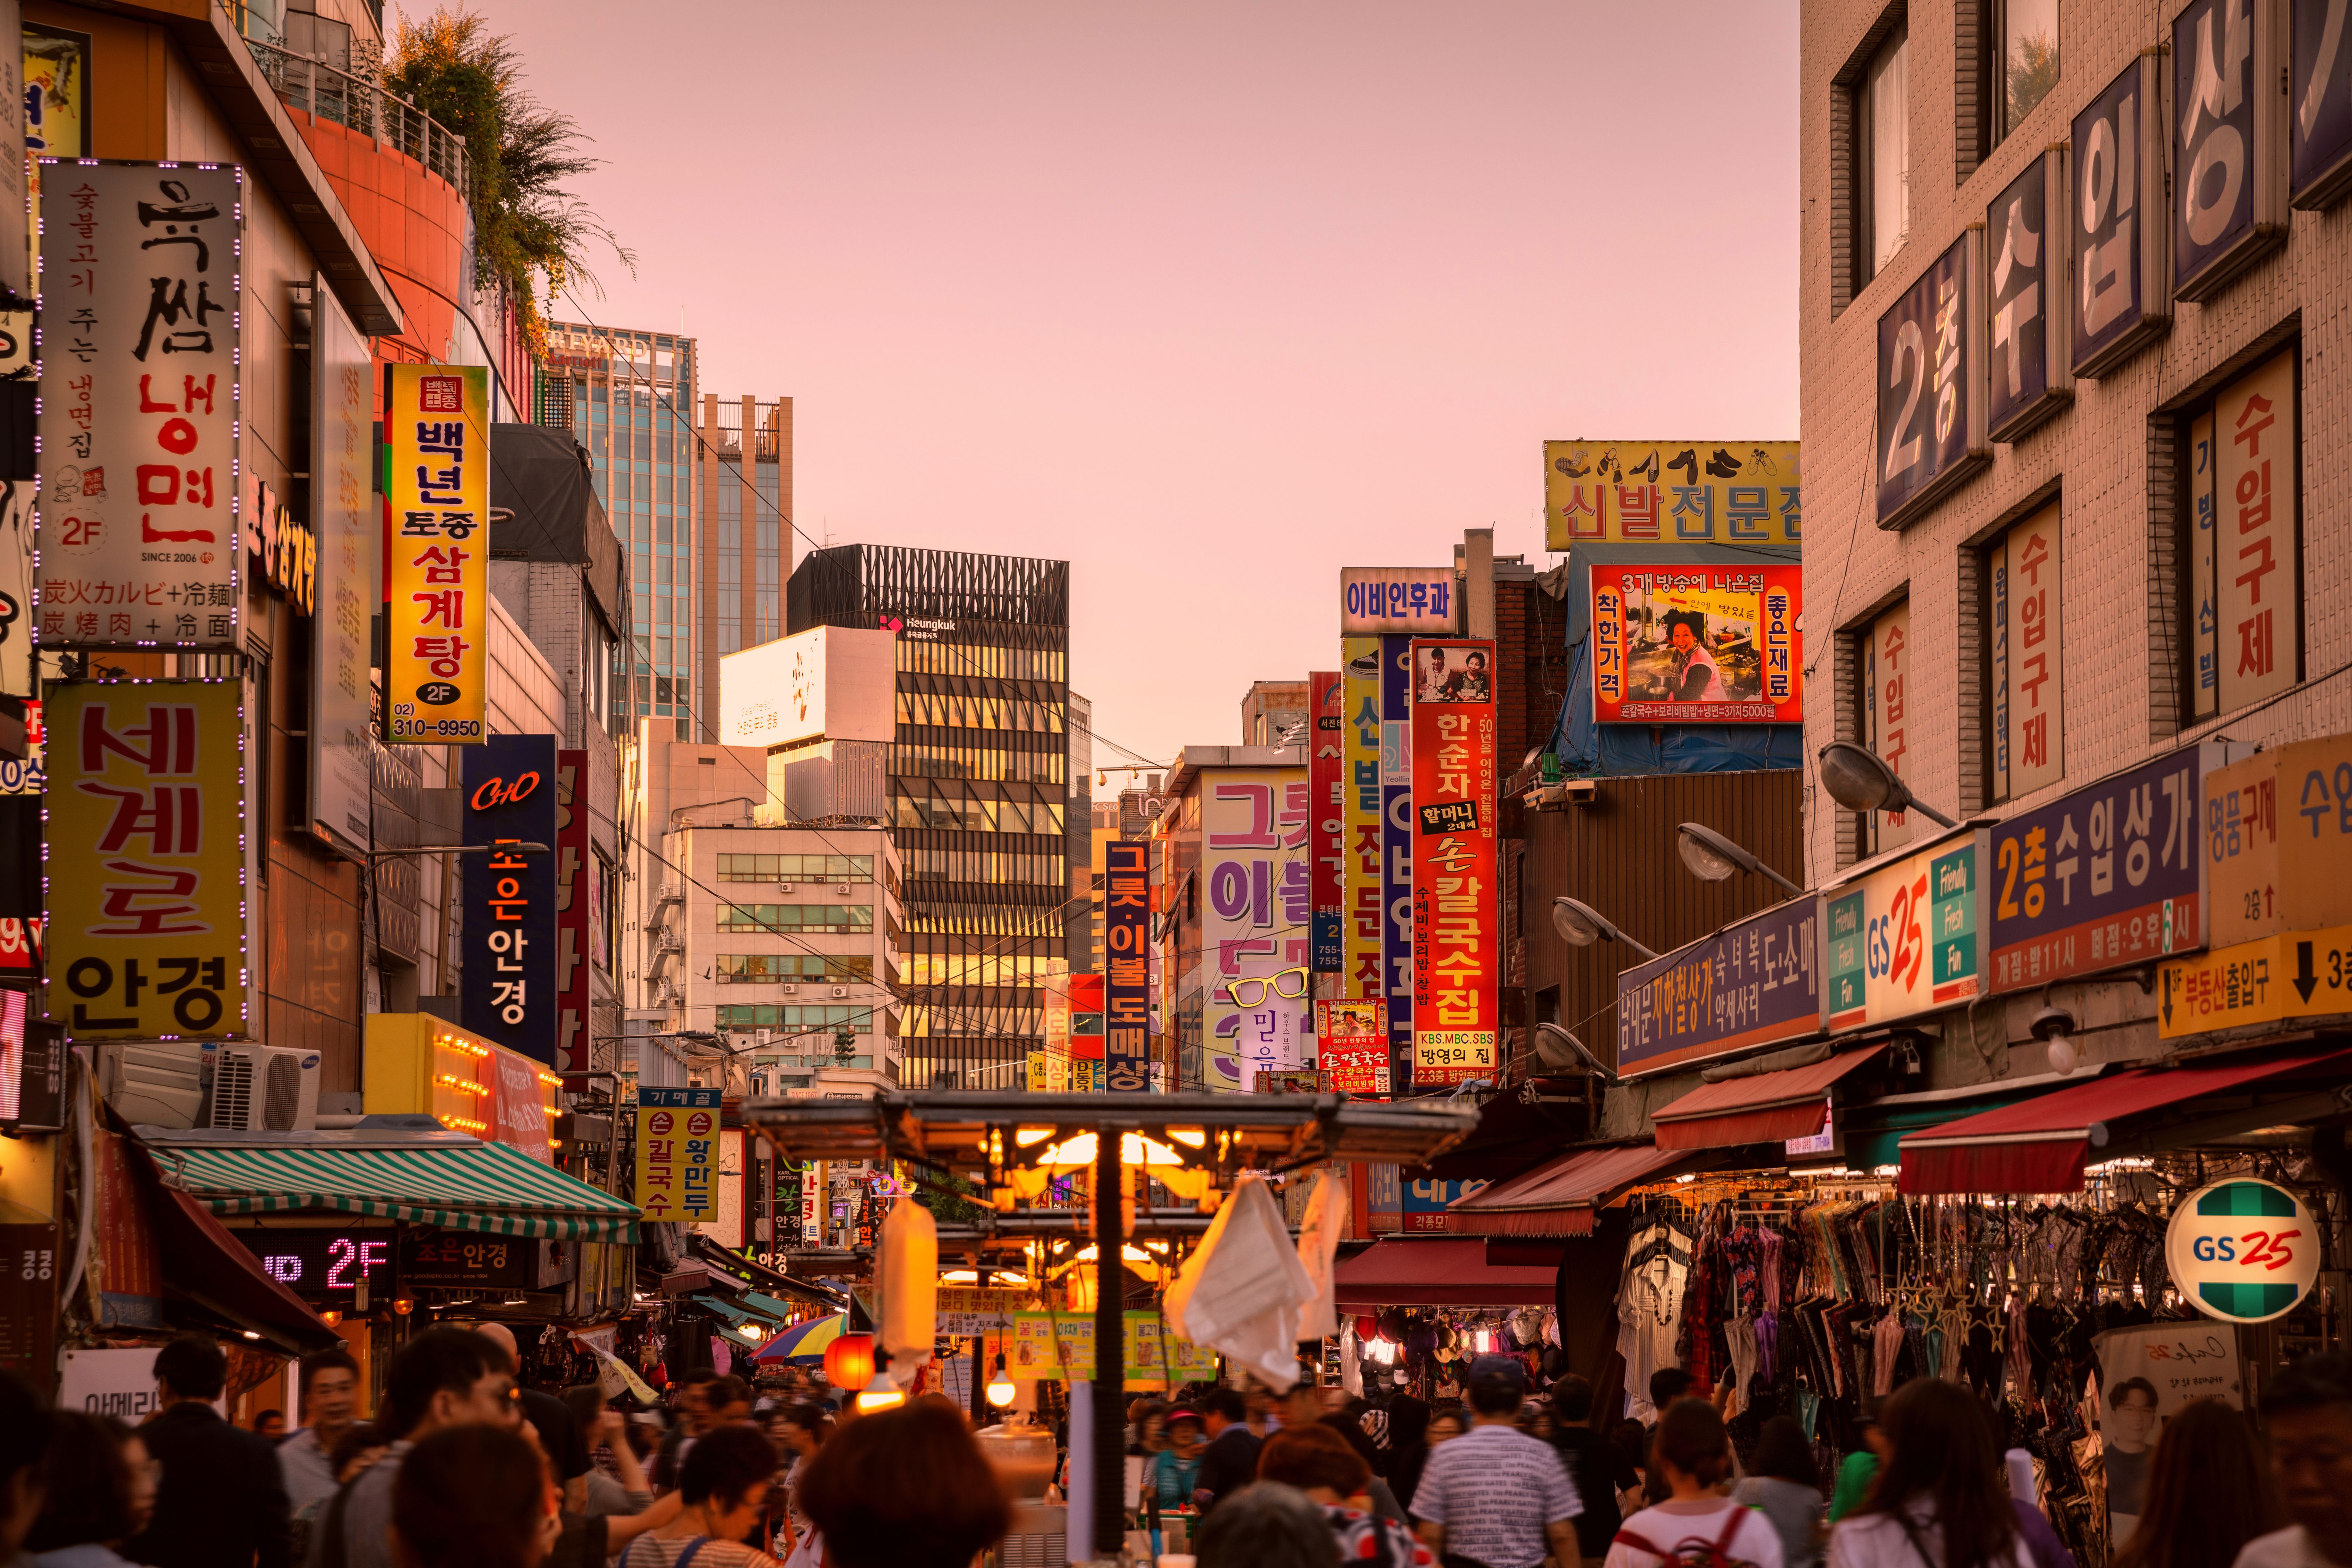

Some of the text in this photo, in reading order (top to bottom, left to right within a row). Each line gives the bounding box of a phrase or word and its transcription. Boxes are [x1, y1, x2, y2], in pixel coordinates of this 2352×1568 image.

[67, 183, 99, 458] 숯불고기 주는 냉면집
[546, 353, 601, 369] Marriott
[1885, 280, 1959, 483] 2층
[417, 421, 464, 505] 백년
[62, 517, 102, 545] 2F
[401, 512, 478, 539] 토종
[2234, 392, 2277, 679] 수입구제
[142, 552, 197, 563] SINCE 2006
[1621, 573, 1765, 596] 3개 방송에 나온집
[412, 546, 472, 680] 삼계탕
[1347, 582, 1449, 618] 이비인후과
[1690, 599, 1711, 611] 안에
[907, 618, 956, 632] Heungkuk
[907, 631, 938, 640] 흥국금융가족
[1598, 594, 1620, 699] 착한가격
[1767, 595, 1790, 698] 좋은재료
[2020, 532, 2049, 768] 수입구제
[427, 686, 449, 701] 2F
[394, 703, 415, 717] 02)
[393, 719, 480, 737] 310-9950
[345, 727, 355, 757] KIDS
[356, 736, 368, 769] PLACE
[1437, 715, 1471, 799] 한순자
[1479, 719, 1493, 838] 50년을 이어온 전통의 집
[75, 704, 213, 936] 세계로
[1422, 804, 1473, 824] 할머니
[1447, 819, 1476, 831] 2대째
[1940, 859, 1967, 897] Friendly
[1835, 899, 1856, 938] Friendly
[1944, 903, 1963, 933] Fresh
[2244, 889, 2261, 921] 2층
[488, 839, 528, 1024] 조은안경
[1427, 837, 1483, 1025] 손칼국수집
[1838, 941, 1854, 969] Fresh
[1947, 942, 1961, 976] Fun
[67, 956, 225, 1031] 안경
[1841, 977, 1852, 1007] Fun
[2172, 969, 2181, 992] 3F
[1378, 1005, 1387, 1035] 좋은재료
[1715, 981, 1759, 1032] 악세사리
[1282, 1012, 1290, 1035] 하우스
[1318, 1007, 1327, 1037] 착한가격
[1282, 1037, 1290, 1060] 브랜드
[1421, 1033, 1493, 1045] KBS.MBC.SBS
[1321, 1051, 1388, 1067] 손칼국수
[1421, 1048, 1490, 1065] 방영의 집
[1338, 1080, 1375, 1088] 보리비빔밥
[645, 1112, 674, 1217] 손칼국수
[683, 1112, 712, 1218] 손왕만두
[775, 1216, 801, 1228] 안경
[328, 1238, 387, 1288] 2F
[416, 1237, 507, 1268] 조은안경
[1057, 1322, 1078, 1336] 야채
